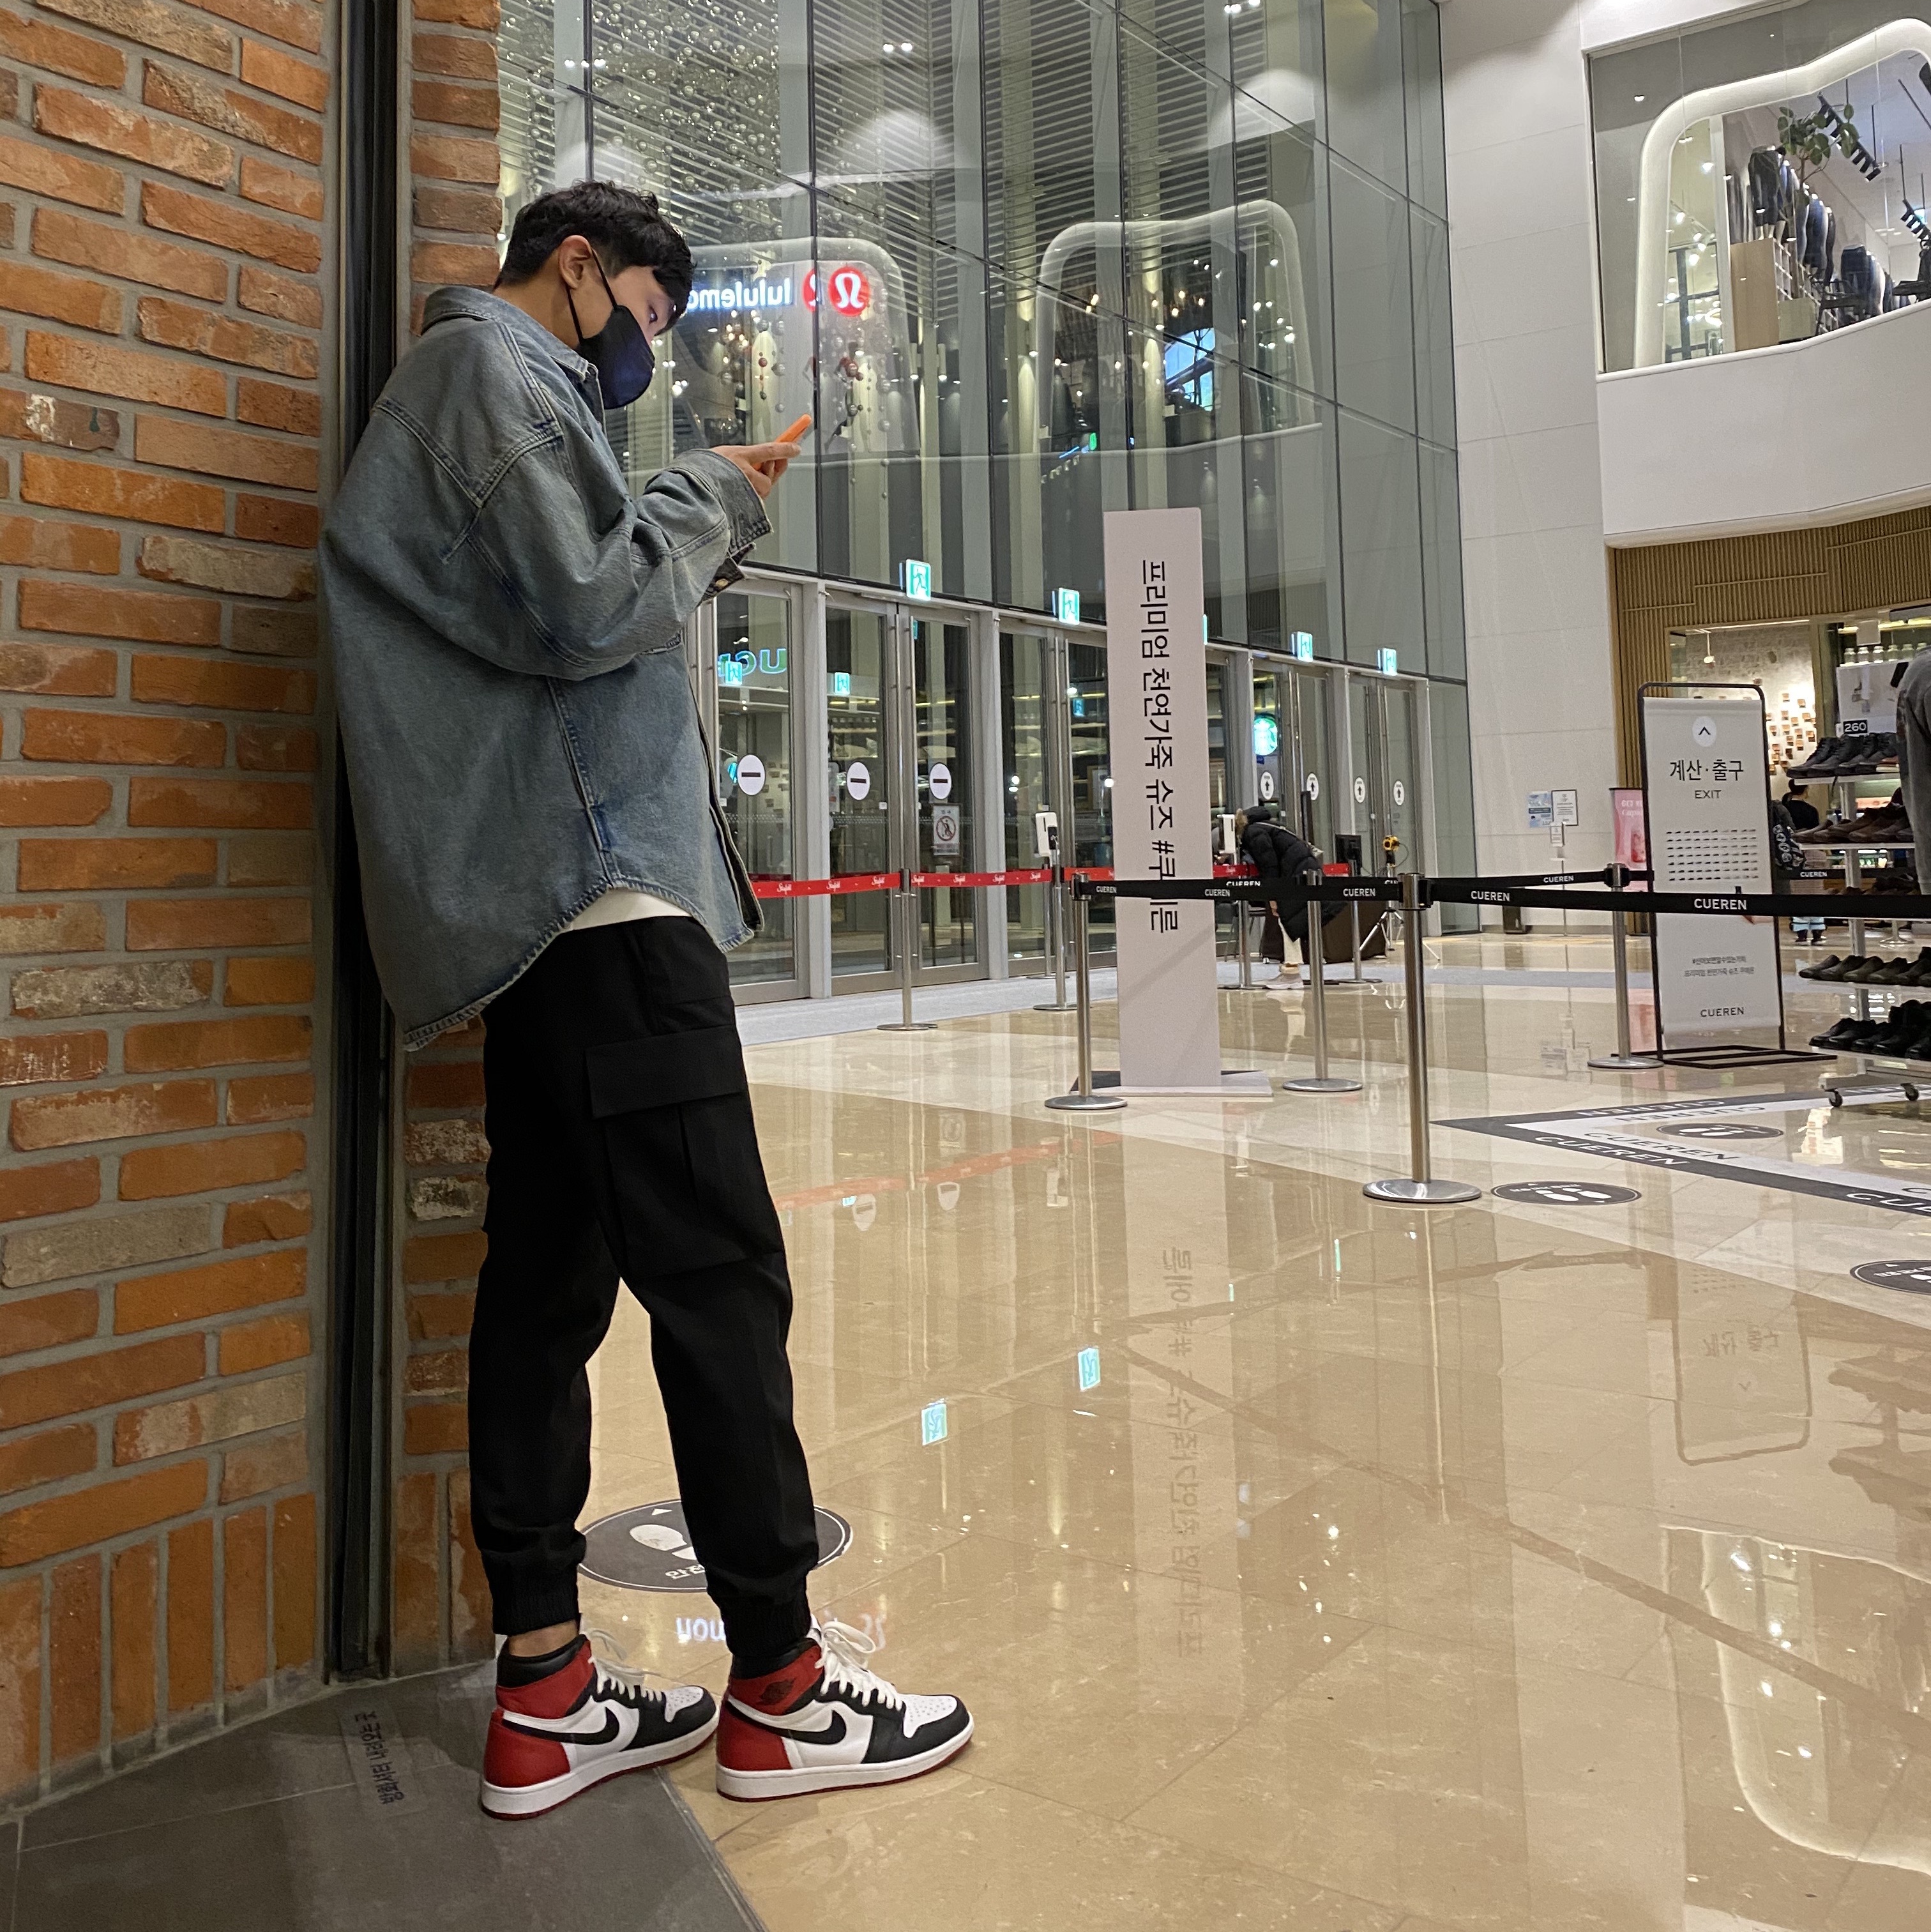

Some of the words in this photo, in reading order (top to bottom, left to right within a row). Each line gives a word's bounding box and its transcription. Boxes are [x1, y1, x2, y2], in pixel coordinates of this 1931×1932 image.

[1140, 559, 1170, 658] 프리미엄
[1143, 668, 1173, 770] 천연가죽
[1844, 722, 1867, 733] 260
[1694, 789, 1722, 799] EXIT
[1146, 779, 1174, 830] 슈즈
[1543, 875, 1575, 883] CUEREN
[1096, 885, 1117, 894] CUEREN
[1204, 888, 1231, 897] CUEREN
[1343, 888, 1376, 897] CUEREN
[1470, 890, 1511, 902] CUEREN
[1693, 898, 1747, 910] CUEREN
[1700, 1007, 1745, 1017] CUEREN
[1534, 1136, 1692, 1166] CUEREN
[1584, 1132, 1741, 1160] CUEREN
